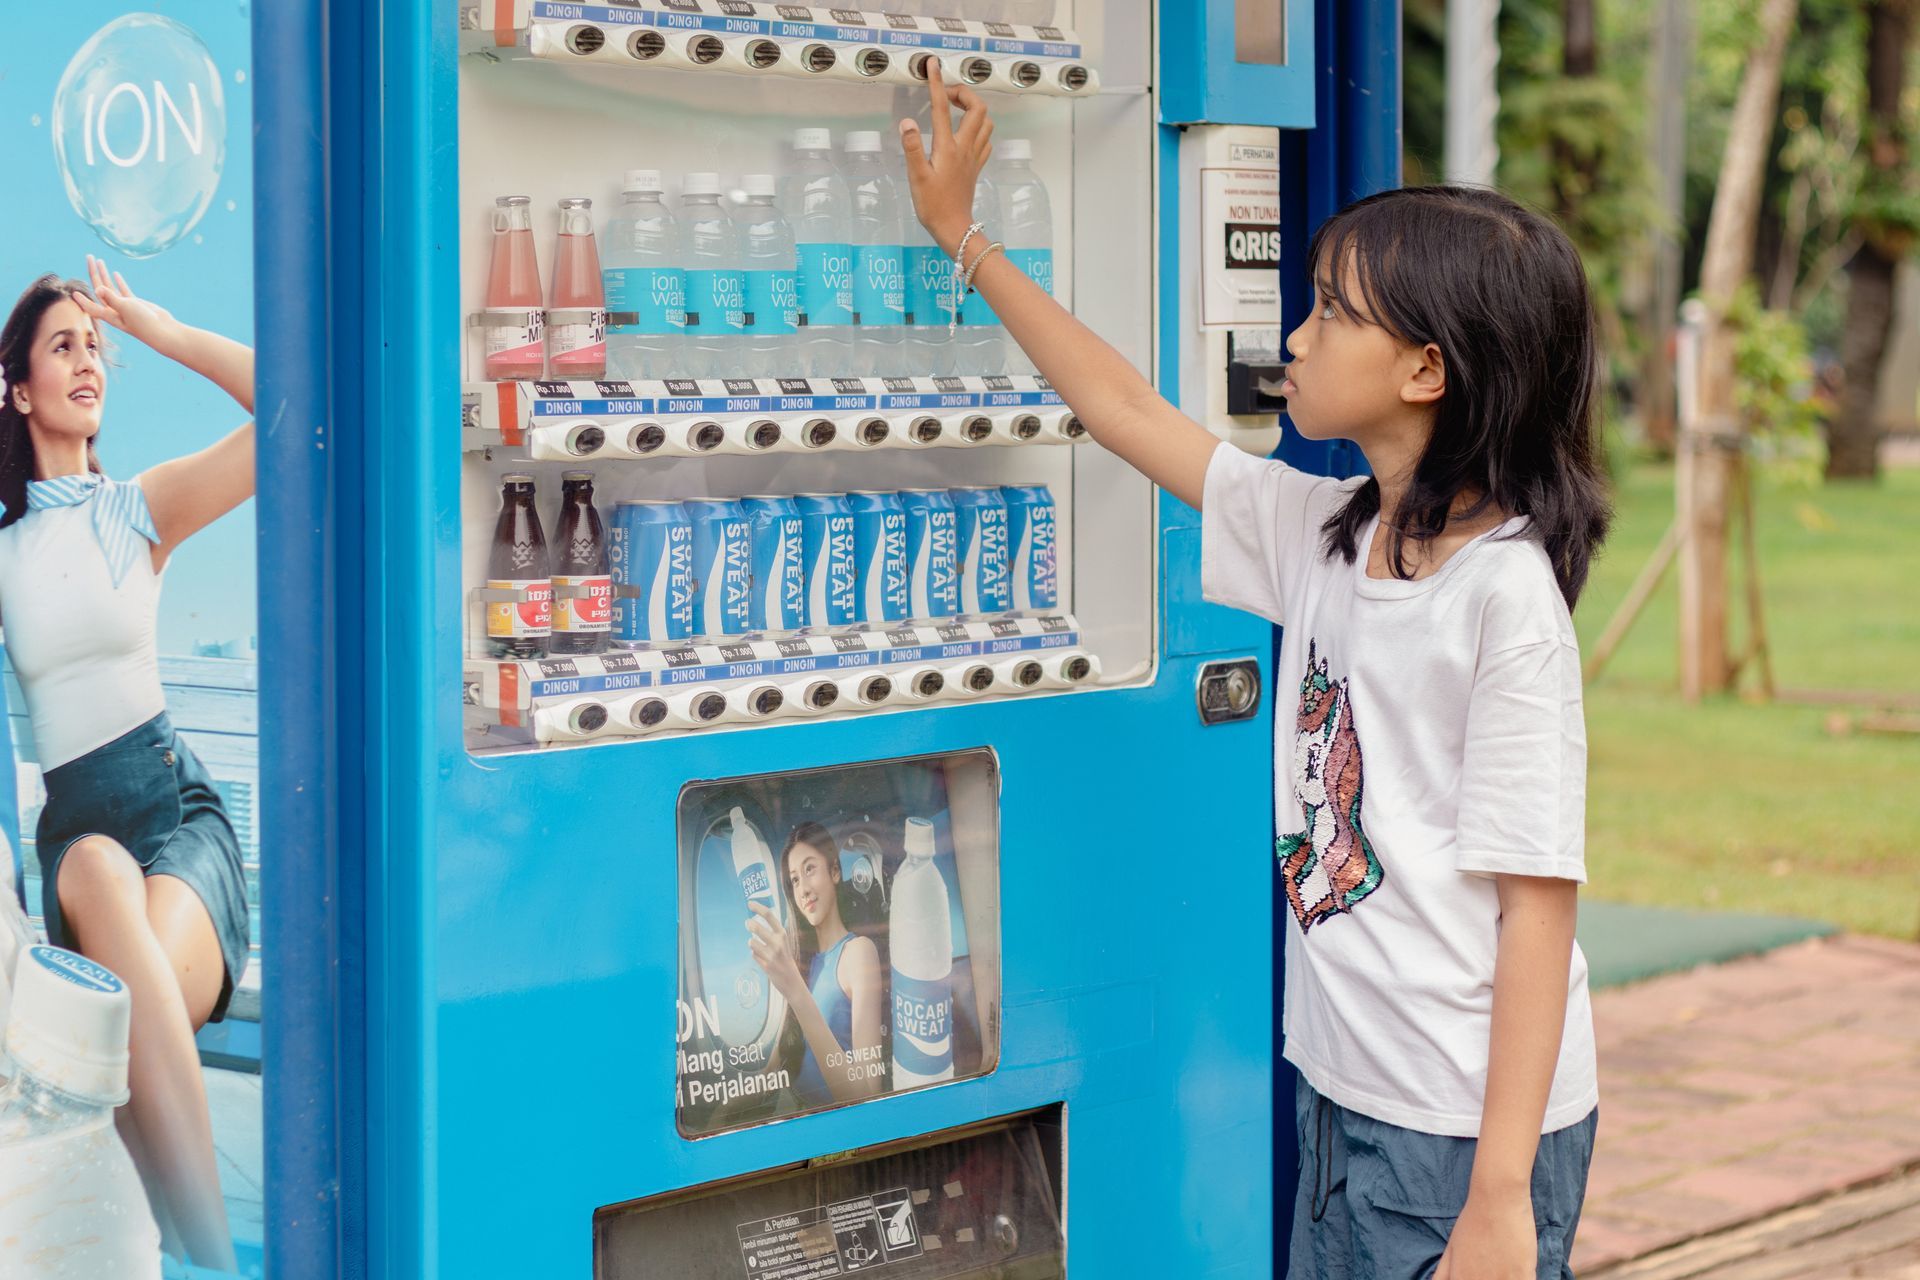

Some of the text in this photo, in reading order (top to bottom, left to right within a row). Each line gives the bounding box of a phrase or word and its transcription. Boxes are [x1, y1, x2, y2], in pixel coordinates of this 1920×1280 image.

[546, 5, 582, 18] DINGIN
[608, 9, 643, 23] DINGIN
[668, 14, 702, 28] DINGIN
[726, 19, 759, 33] DINGIN
[782, 24, 815, 37] DINGIN
[837, 28, 868, 41] DINGIN
[890, 32, 920, 45] DINGIN
[942, 37, 972, 49] DINGIN
[994, 40, 1024, 53] DINGIN
[1043, 44, 1072, 56] DINGIN
[83, 80, 203, 168] ION
[1229, 206, 1250, 219] NON
[1229, 230, 1281, 263] QRIS
[822, 252, 849, 272] ion
[868, 254, 897, 274] ion
[922, 255, 950, 275] ion
[1028, 257, 1051, 276] ion
[652, 271, 679, 291] ion
[713, 273, 738, 293] ion
[771, 273, 794, 293] ion
[550, 385, 571, 394] 7.000
[611, 384, 632, 393] 7.000
[669, 400, 703, 412] DINGIN
[727, 399, 760, 411] DINGIN
[781, 398, 813, 410] DINGIN
[835, 397, 866, 409] DINGIN
[890, 396, 920, 408] DINGIN
[941, 395, 971, 406] DINGIN
[992, 394, 1022, 405] DINGIN
[1041, 393, 1064, 405] DING
[546, 402, 582, 414] DINGIN
[608, 401, 643, 413] DINGIN
[932, 511, 947, 602] SWEAT
[981, 509, 998, 598] SWEAT
[1032, 506, 1047, 594] SWEAT
[1046, 506, 1057, 603] POCARI
[831, 516, 846, 610] SWEAT
[886, 514, 900, 606] SWEAT
[946, 511, 956, 612] POCARI
[996, 508, 1008, 607] POCARI
[727, 523, 741, 619] SWEAT
[786, 520, 799, 614] SWEAT
[845, 516, 854, 619] POCARI
[671, 527, 685, 623] SWEAT
[684, 526, 692, 633] POCARI
[741, 523, 749, 628] POCARI
[541, 602, 549, 613] C
[598, 597, 607, 608] C
[846, 637, 864, 647] 7.000
[899, 632, 917, 641] 7.000
[1041, 634, 1069, 648] DINGIN
[733, 647, 752, 657] 7.000
[791, 643, 809, 652] 7.000
[942, 643, 972, 657] DINGIN
[992, 639, 1021, 652] DINGIN
[616, 657, 637, 667] 7.000
[678, 651, 698, 661] 7.000
[838, 653, 869, 667] DINGIN
[891, 648, 921, 662] DINGIN
[554, 663, 575, 673] 7.000
[730, 663, 762, 676] DINGIN
[784, 658, 816, 672] DINGIN
[605, 675, 640, 689] DINGIN
[672, 668, 706, 682] DINGIN
[543, 680, 579, 694] DINGIN
[896, 994, 948, 1020] POCARI
[896, 1015, 945, 1036] SWEAT
[728, 1039, 766, 1066] saat
[826, 1045, 883, 1068] GO SWEAT
[847, 1061, 886, 1082] GO ION
[689, 1068, 790, 1106] Perjalanan
[771, 1215, 799, 1230] Perhatian
[742, 1235, 779, 1250] Ambil minuman
